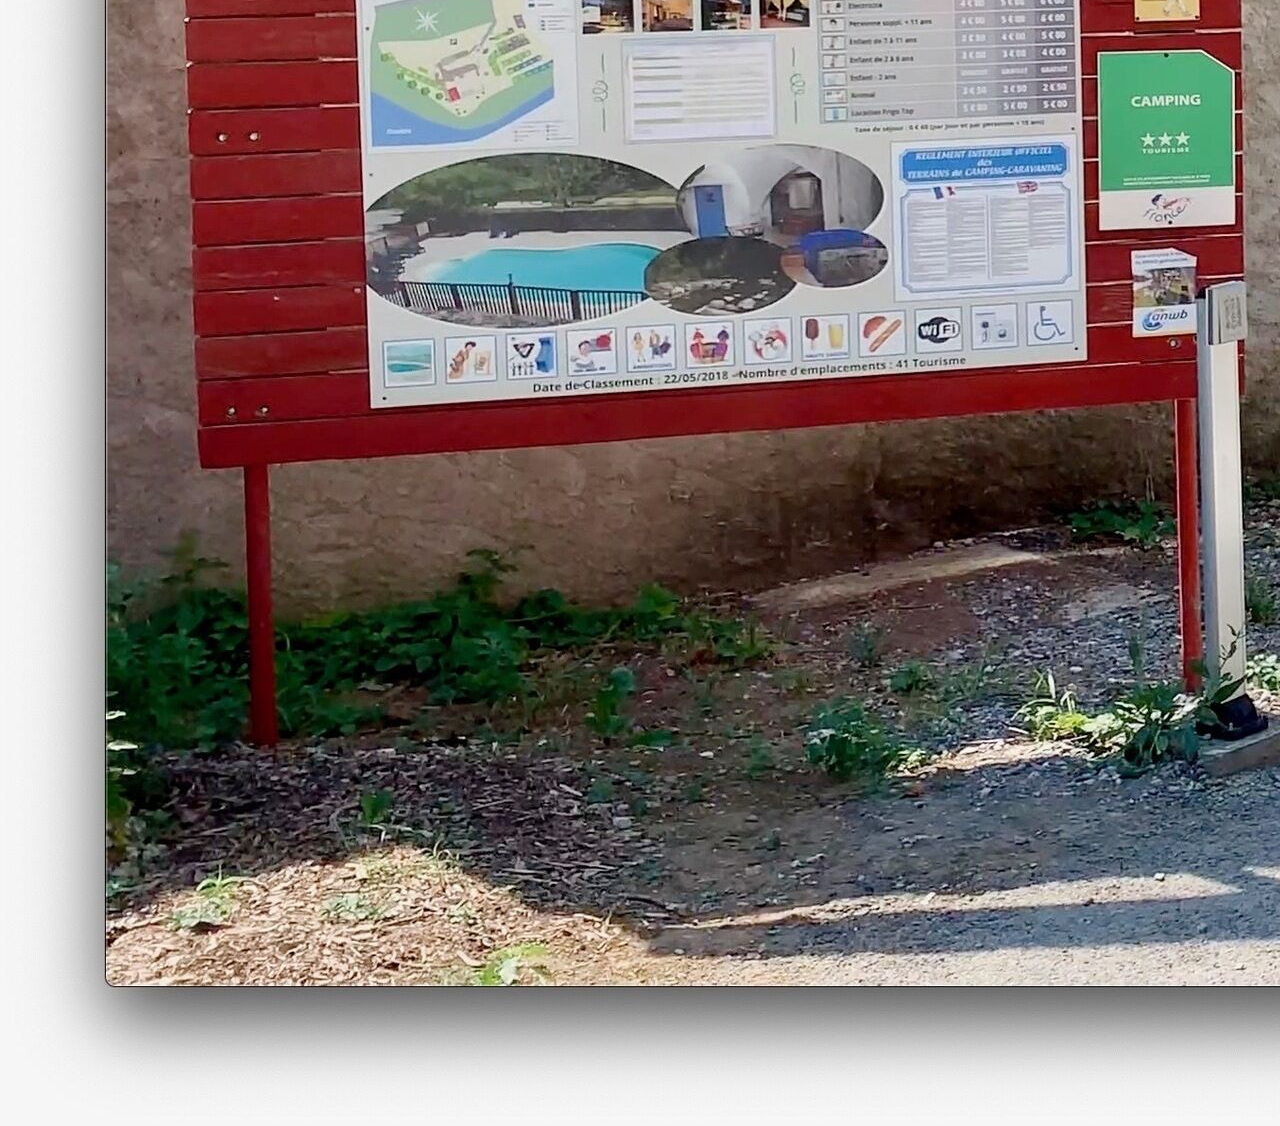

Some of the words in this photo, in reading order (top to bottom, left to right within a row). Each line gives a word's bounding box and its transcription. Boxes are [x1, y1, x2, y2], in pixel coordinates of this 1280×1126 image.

[1131, 94, 1201, 107] CAMPING
[533, 382, 561, 393] Date
[664, 371, 728, 384] 22/05/2018
[896, 359, 908, 368] 41
[912, 355, 966, 368] Tourisme
